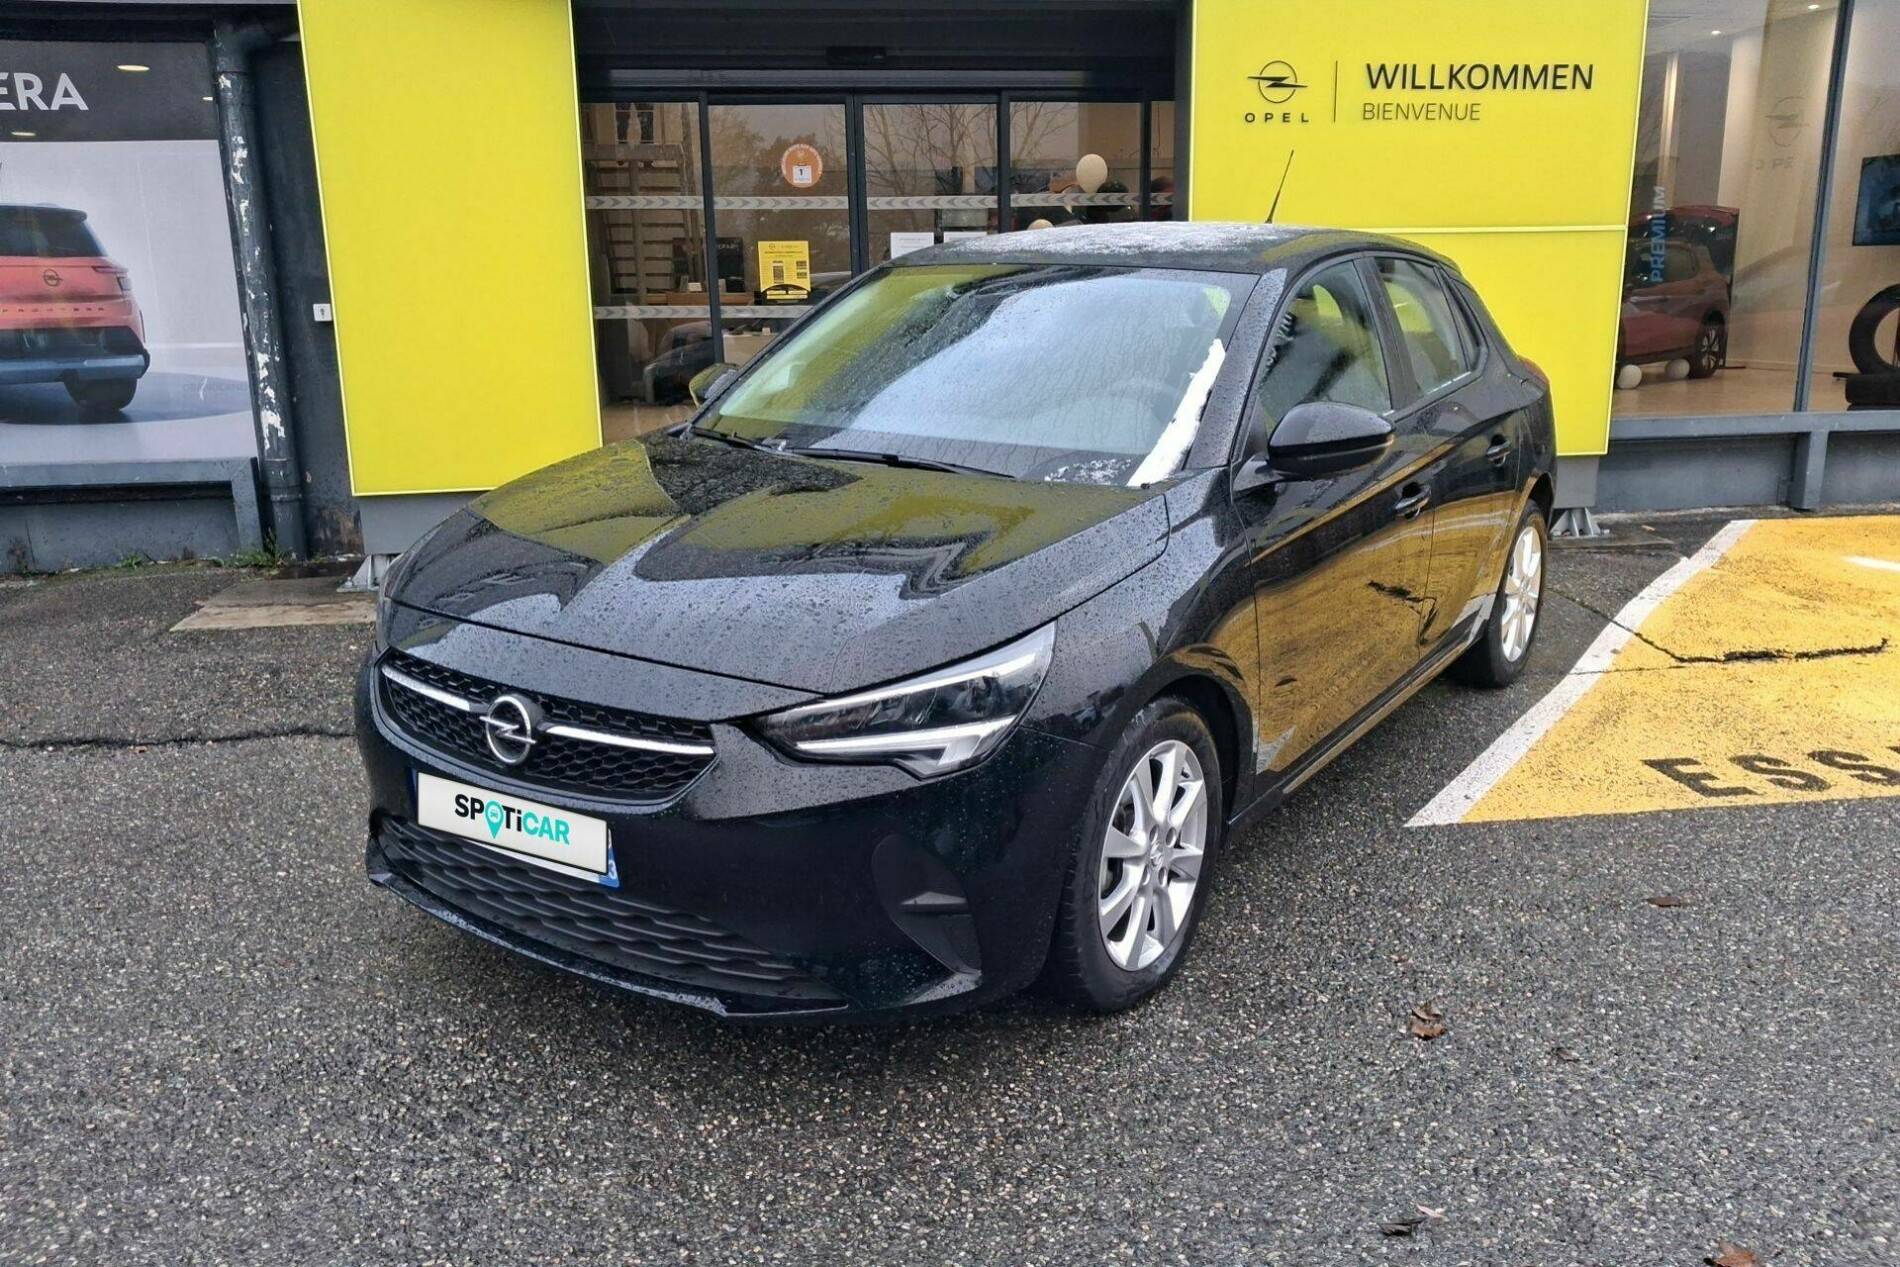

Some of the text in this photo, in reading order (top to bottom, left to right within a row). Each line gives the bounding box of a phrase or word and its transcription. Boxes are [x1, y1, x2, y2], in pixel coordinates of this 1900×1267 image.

[1366, 63, 1594, 90] WILLKOMMEN
[1244, 112, 1310, 124] OPEL
[1362, 102, 1481, 121] BIENVENUE
[1650, 185, 1666, 283] PREMIUM
[1640, 746, 1900, 798] ESS
